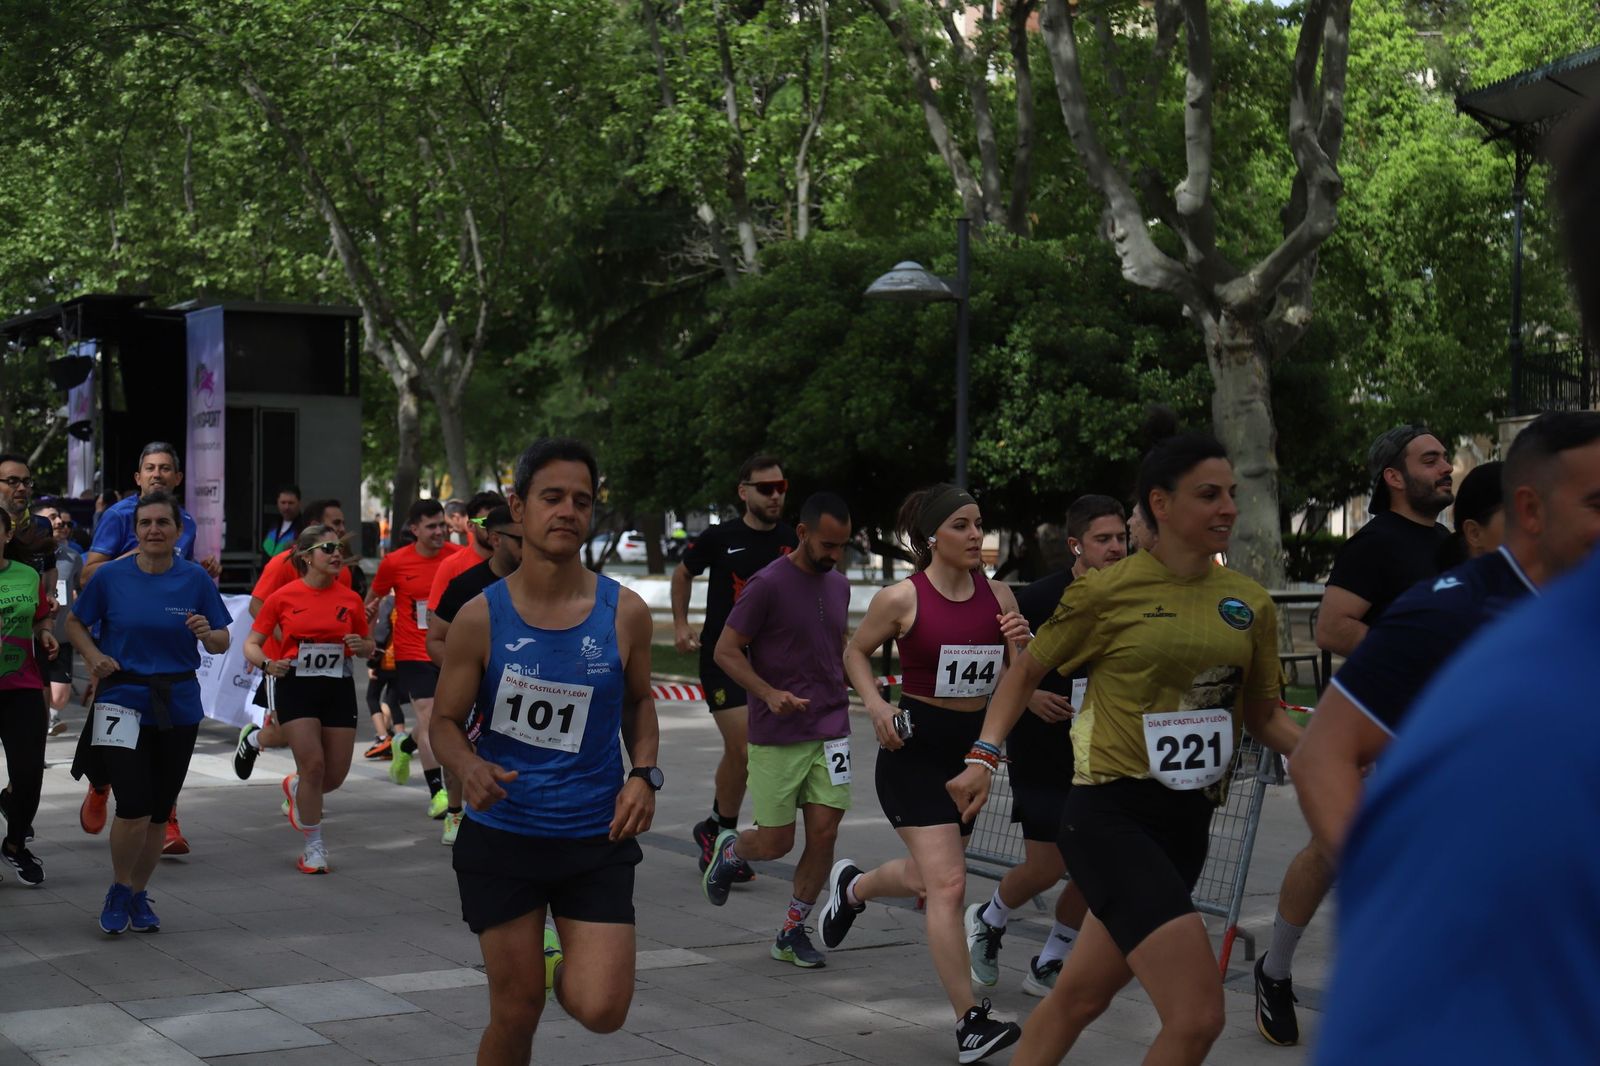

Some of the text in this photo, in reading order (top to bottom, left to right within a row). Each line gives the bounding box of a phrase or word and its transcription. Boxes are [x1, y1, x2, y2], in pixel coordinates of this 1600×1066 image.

[303, 653, 340, 669] 107
[945, 660, 995, 685] 144
[505, 676, 517, 685] DÍA
[518, 681, 529, 690] DE
[529, 684, 561, 695] CASTILLA
[568, 689, 588, 699] LEÓN
[106, 716, 120, 735] 7
[506, 694, 576, 734] 101
[1148, 720, 1162, 728] DÍA
[1162, 719, 1172, 727] DE
[1173, 716, 1206, 726] CASTILLA
[1210, 714, 1228, 723] LEÓN
[1157, 732, 1221, 771] 221
